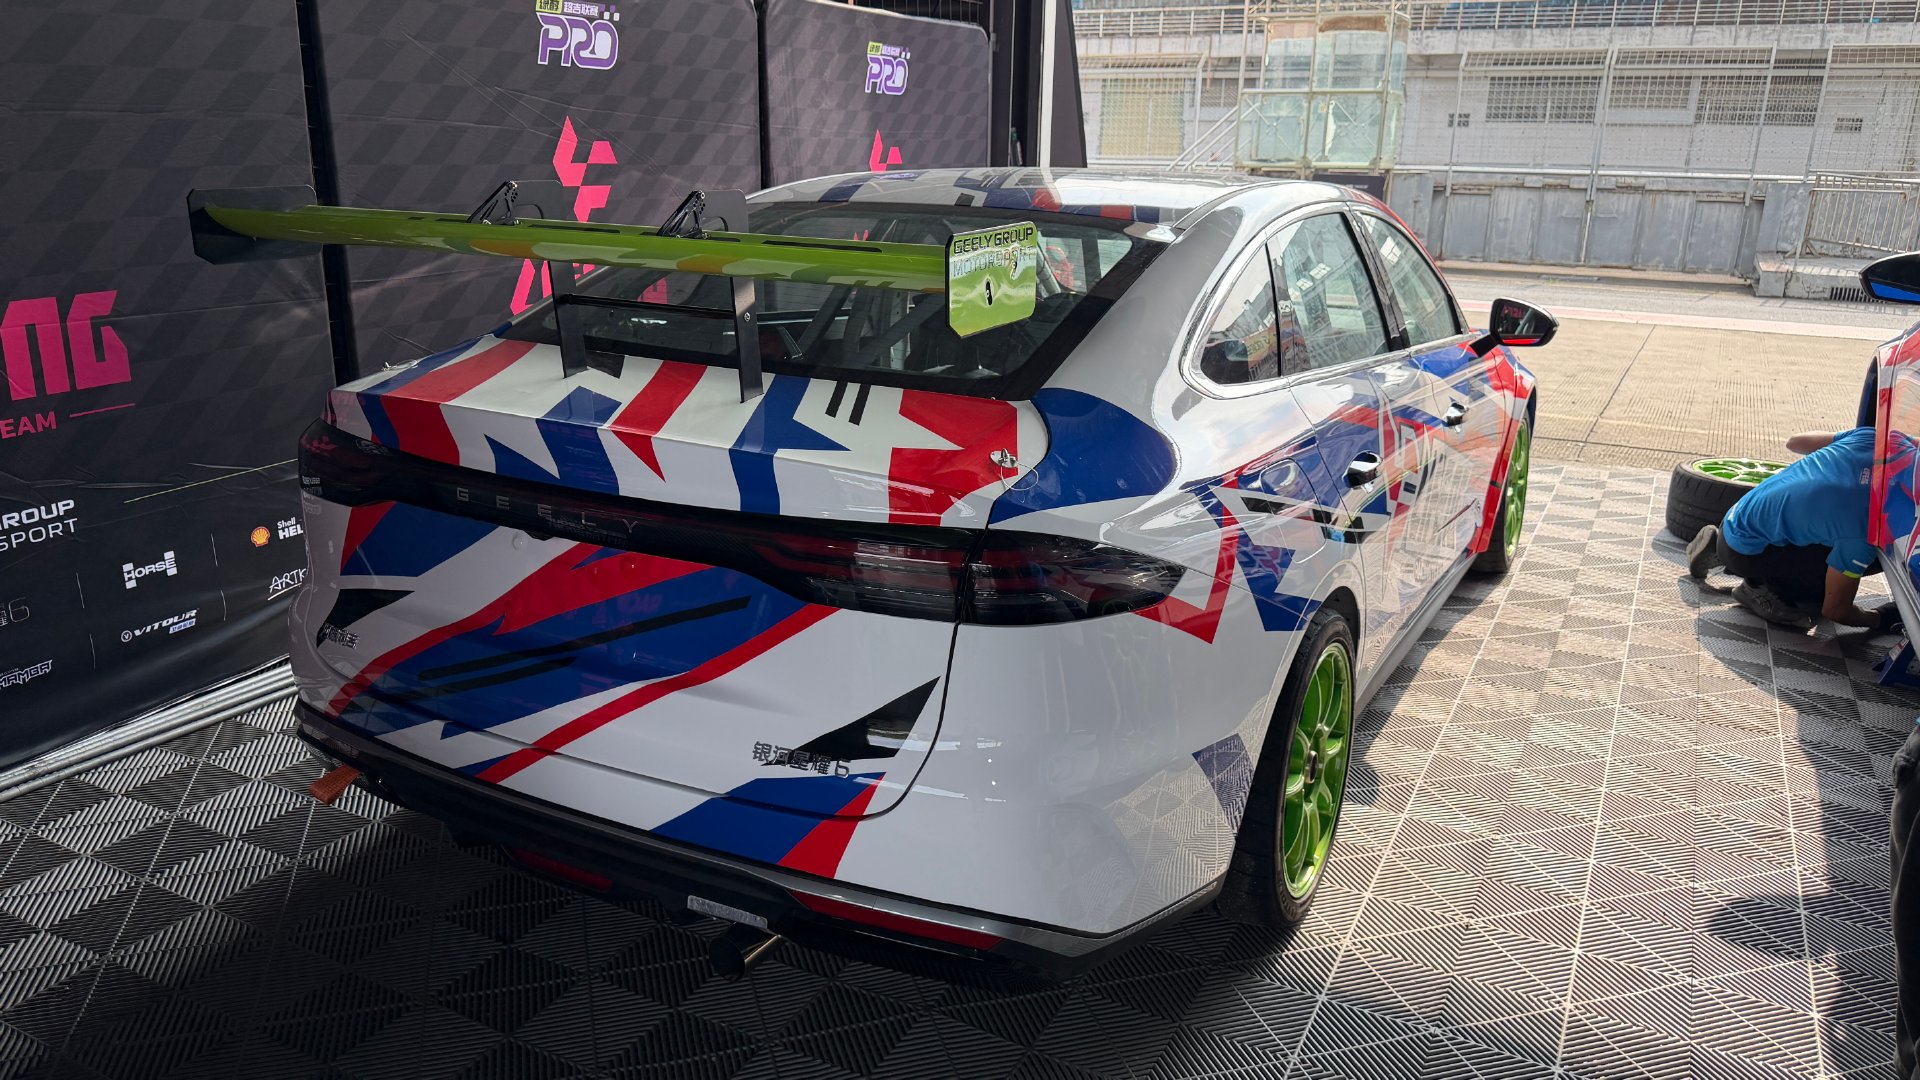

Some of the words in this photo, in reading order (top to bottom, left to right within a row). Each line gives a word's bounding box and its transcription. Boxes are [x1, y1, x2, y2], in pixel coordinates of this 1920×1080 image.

[563, 1, 599, 16] 超吉联赛
[536, 12, 619, 70] PRO
[865, 55, 909, 95] PRO
[953, 235, 993, 254] GEELY
[994, 227, 1034, 247] GROUP
[0, 499, 75, 531] ROUP
[277, 516, 296, 529] Shell
[456, 487, 639, 534] GEELY
[123, 552, 178, 587] HORSE
[134, 609, 198, 637] VITOUR
